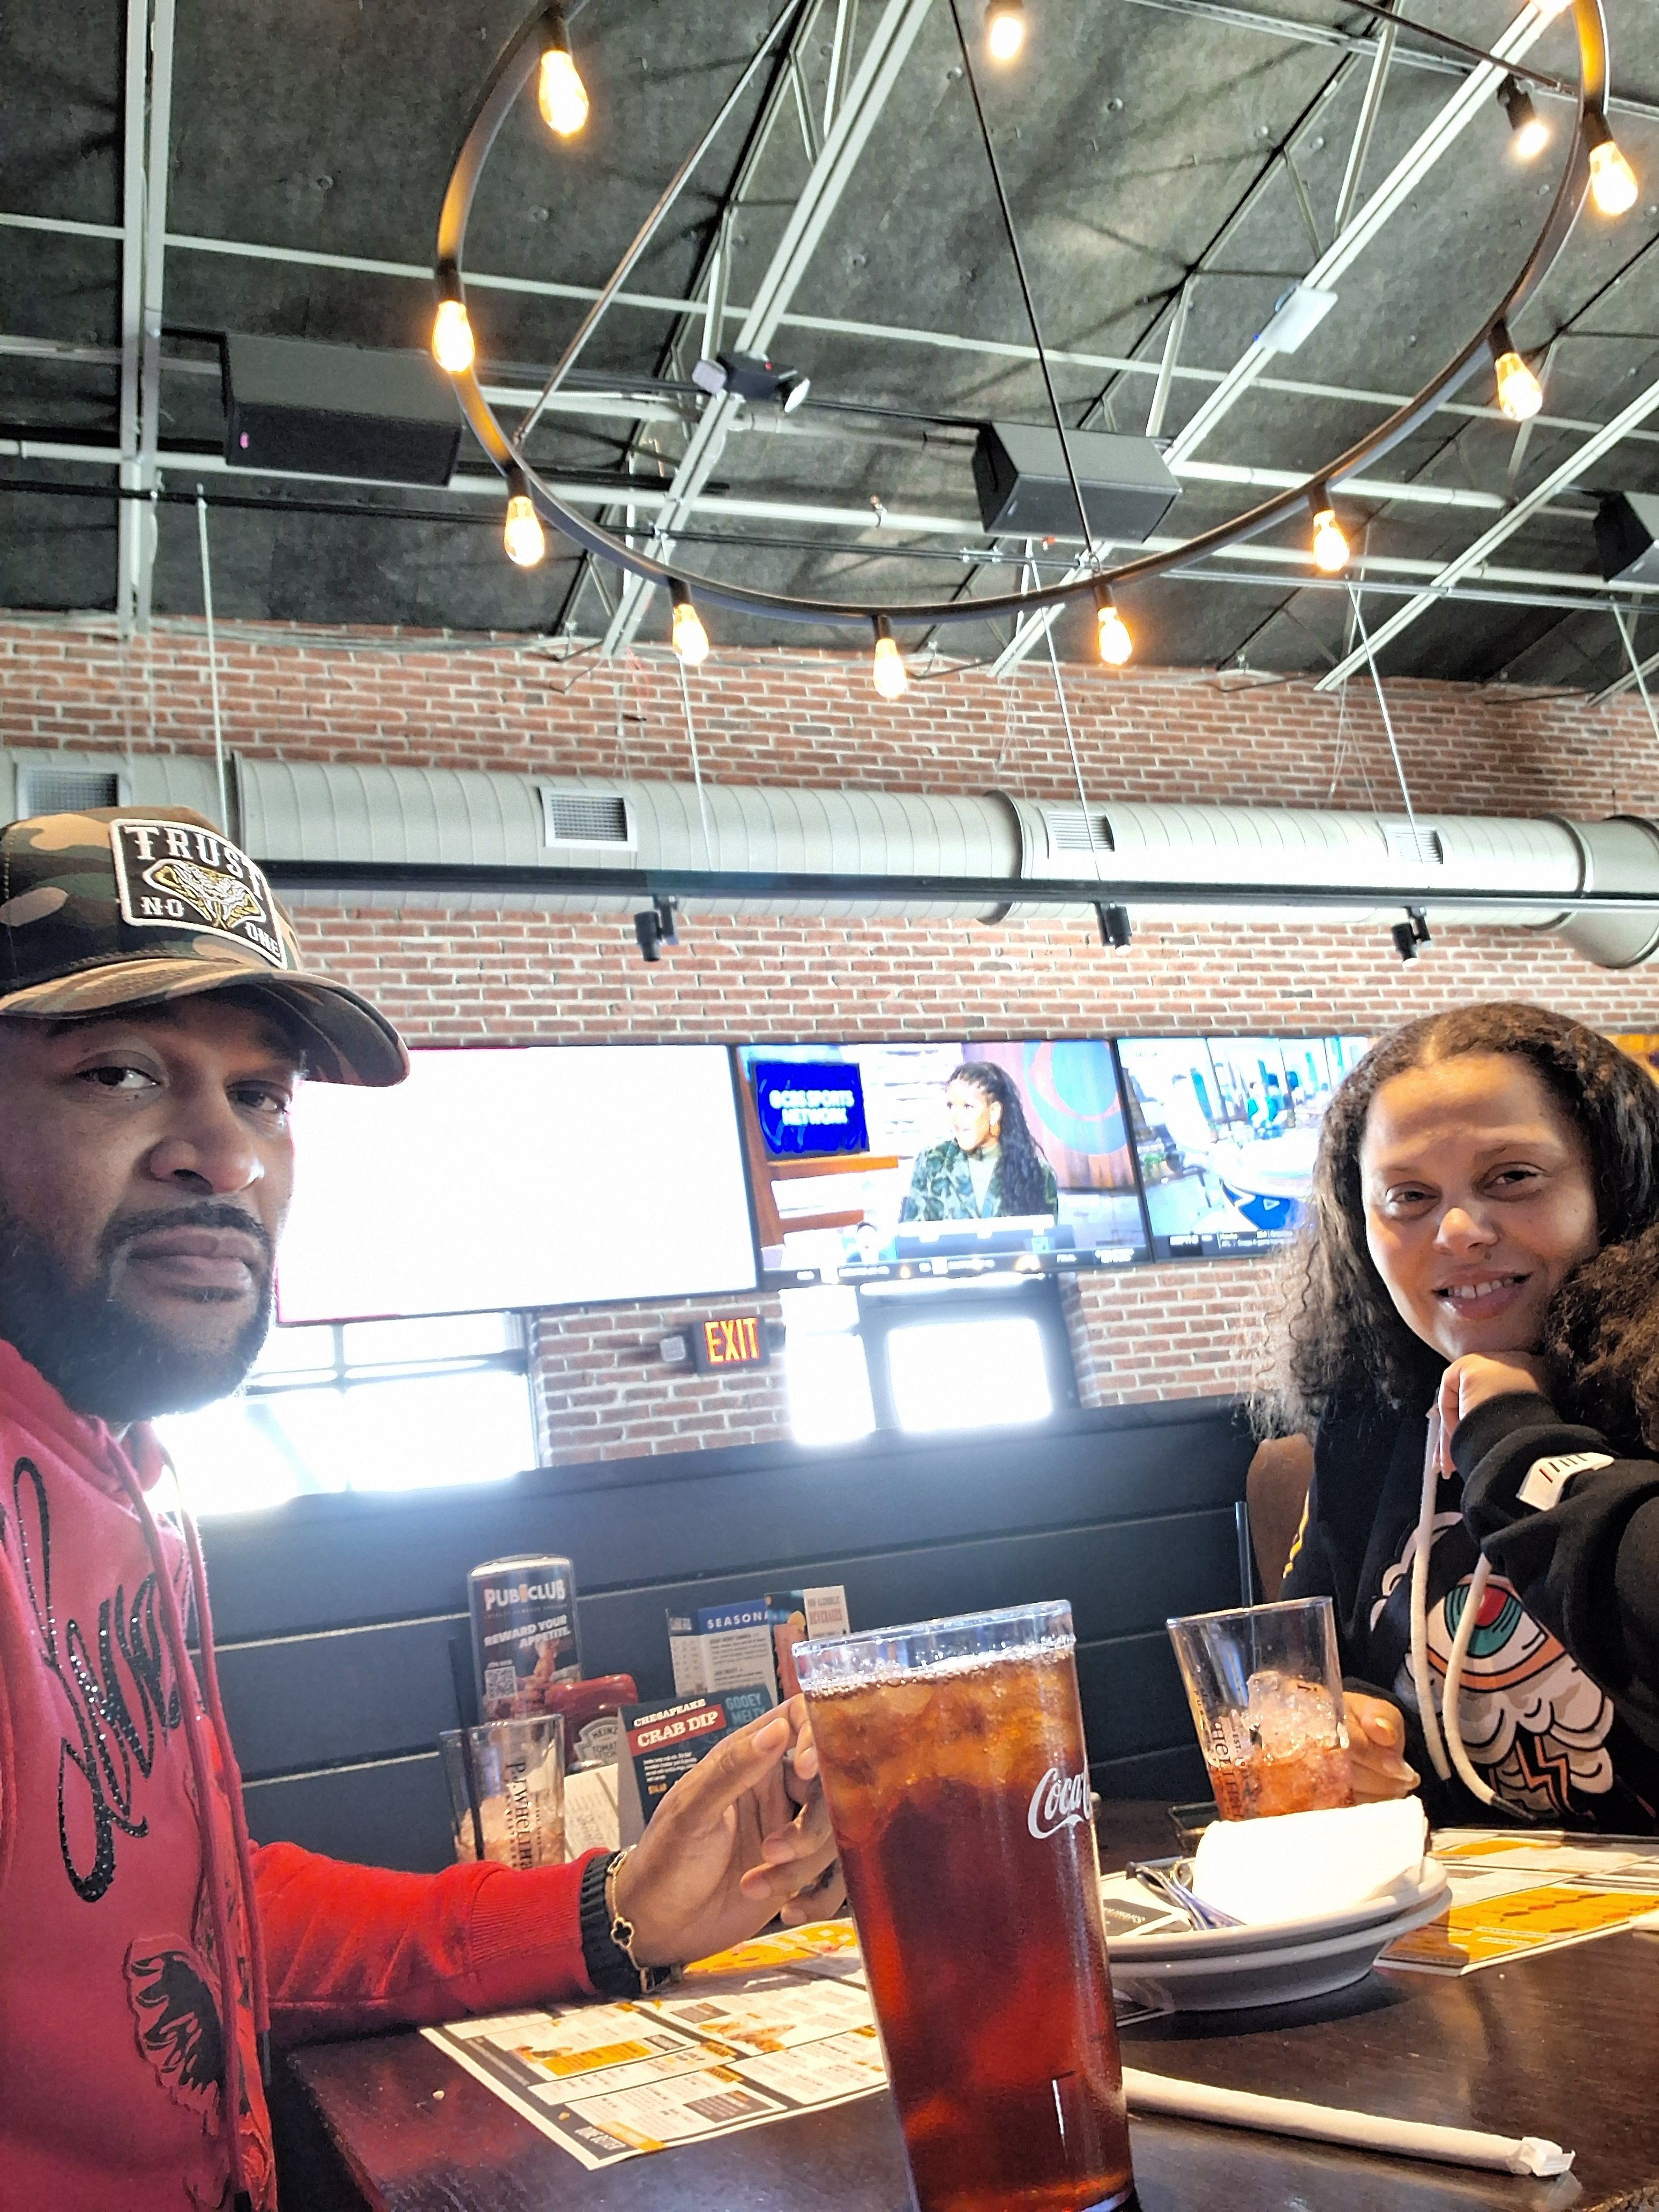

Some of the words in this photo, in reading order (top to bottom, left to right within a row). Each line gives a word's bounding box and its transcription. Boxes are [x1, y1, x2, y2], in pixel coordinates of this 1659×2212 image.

[124, 826, 264, 901] TRUST
[140, 896, 185, 918] NO
[244, 921, 281, 959] ONE
[704, 1316, 760, 1365] EXIT
[483, 1587, 519, 1611] PUB
[527, 1579, 566, 1601] CLUB
[484, 1623, 537, 1647] REWARD
[633, 1698, 706, 1728] CHESAPEAKE
[726, 1692, 761, 1711] GOOEY
[637, 1722, 686, 1747] CRAB
[686, 1710, 718, 1731] DIP
